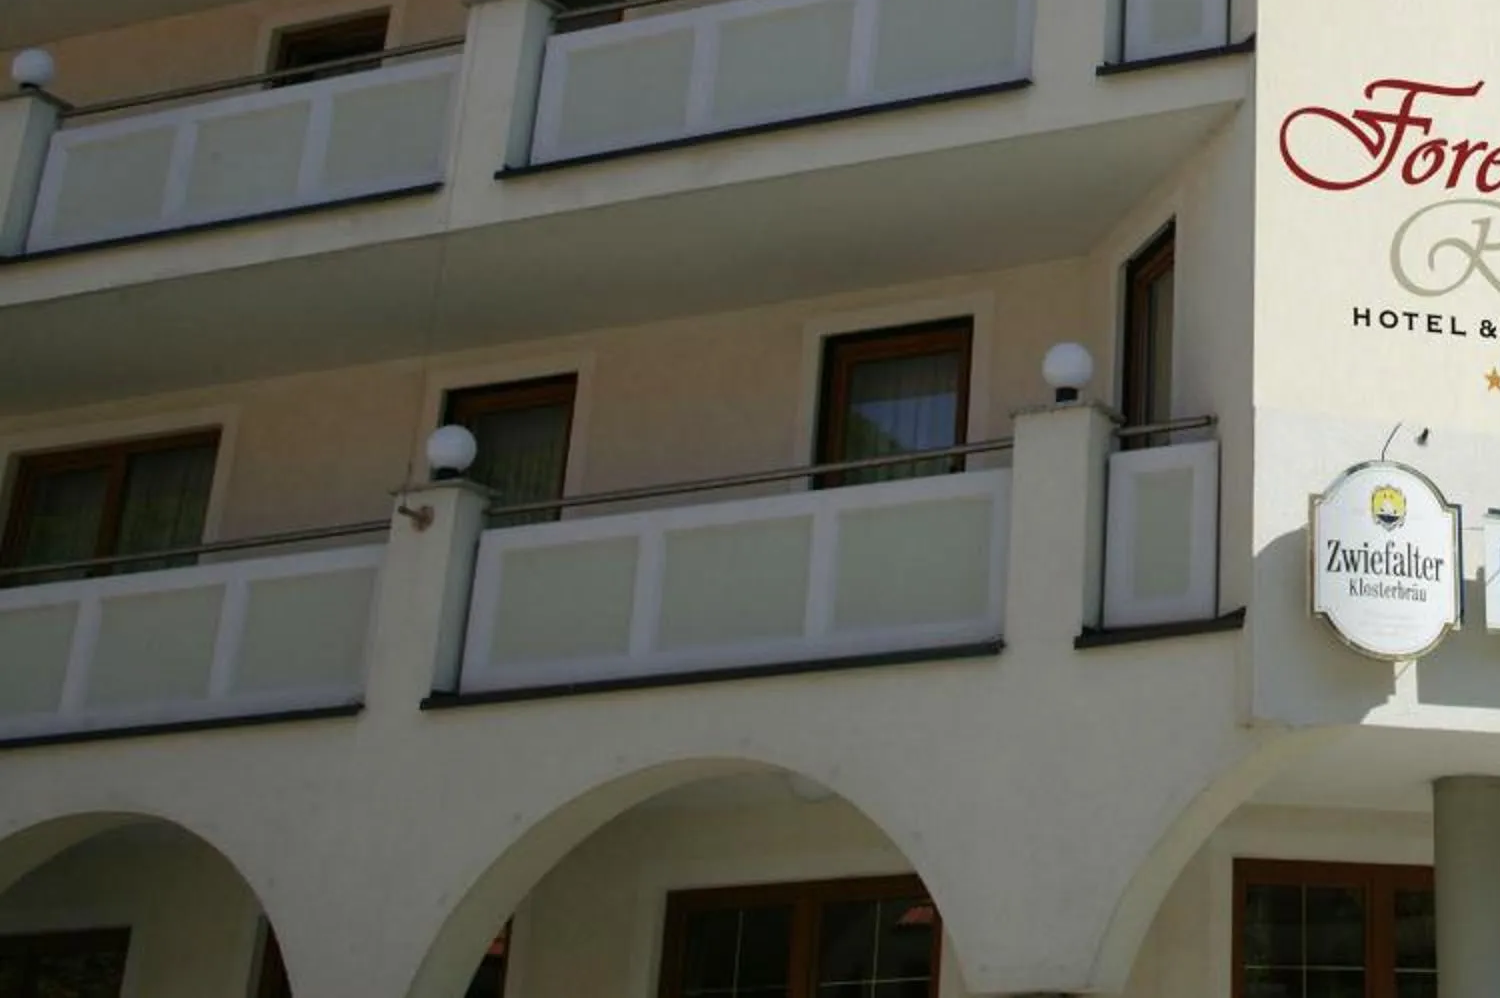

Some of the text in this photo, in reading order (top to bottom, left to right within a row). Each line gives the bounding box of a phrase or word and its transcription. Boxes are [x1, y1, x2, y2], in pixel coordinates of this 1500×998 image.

[1352, 307, 1467, 337] HOTEL
[1479, 319, 1498, 339] &
[1326, 539, 1444, 582] Zwiefalter
[1348, 578, 1428, 603] Klosterbräu
